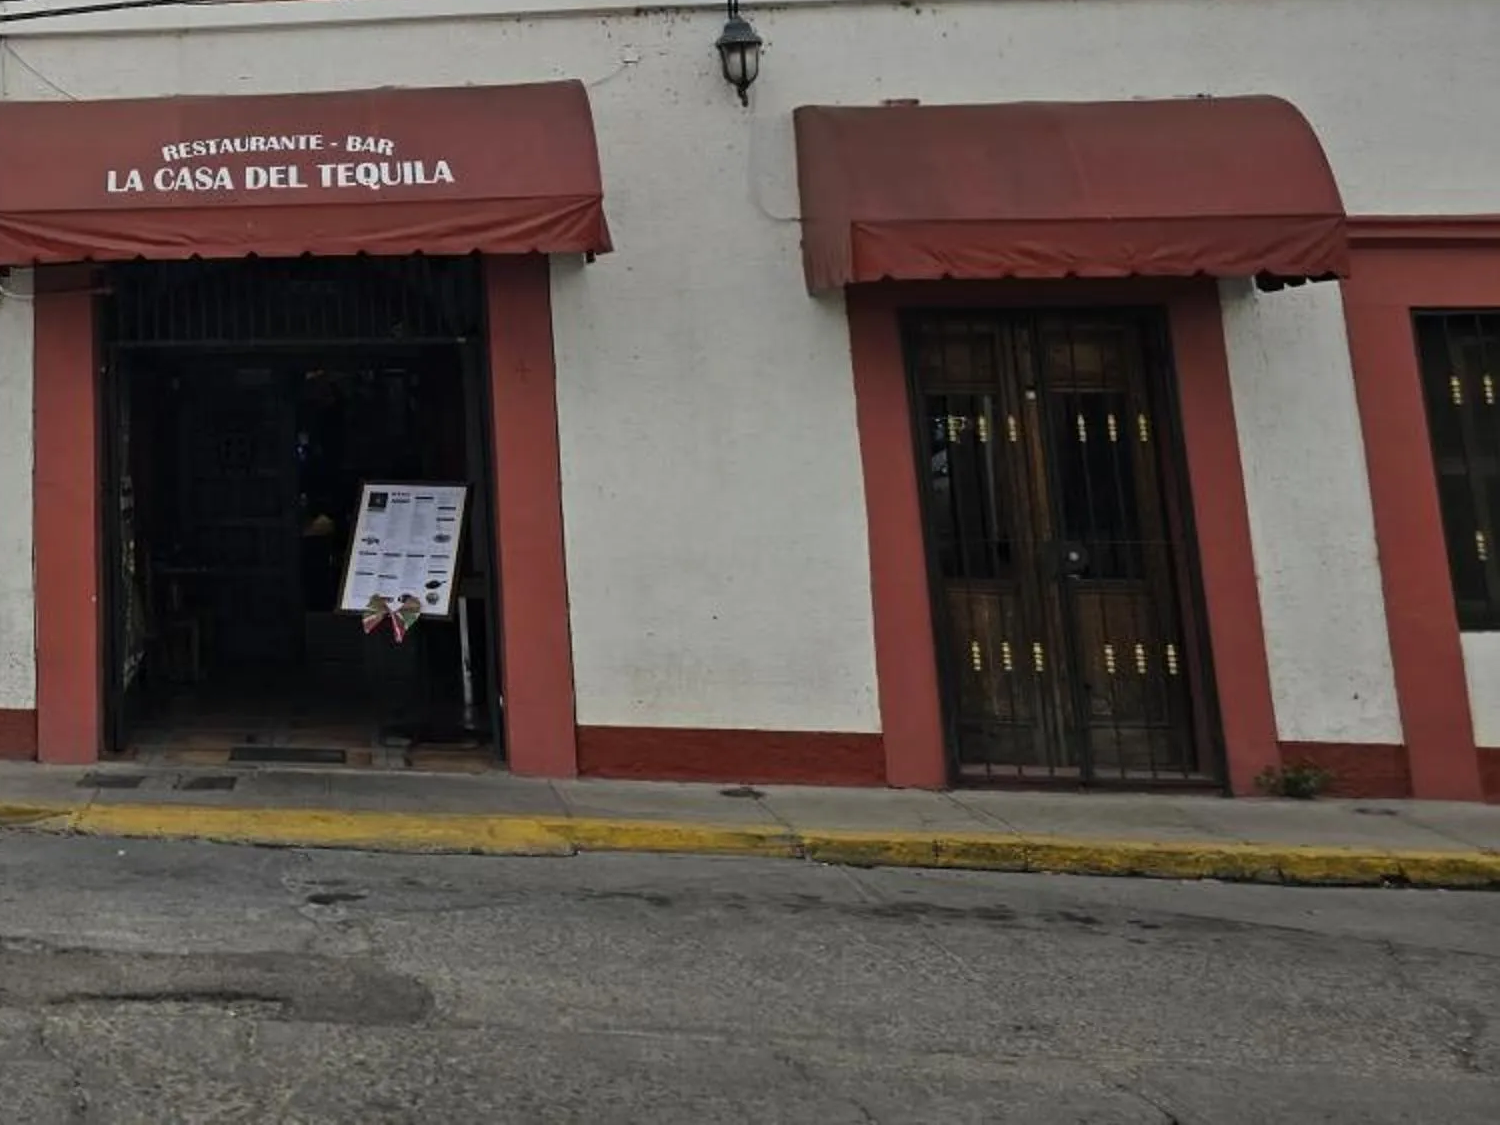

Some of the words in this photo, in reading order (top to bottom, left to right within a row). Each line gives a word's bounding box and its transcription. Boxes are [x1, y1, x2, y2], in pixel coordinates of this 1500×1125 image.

[162, 133, 324, 162] RESTAURANTE
[346, 134, 395, 156] BAR
[106, 170, 144, 193] LA
[153, 166, 235, 192] CASA
[244, 163, 308, 191] DEL
[316, 160, 455, 191] TEQUILA
